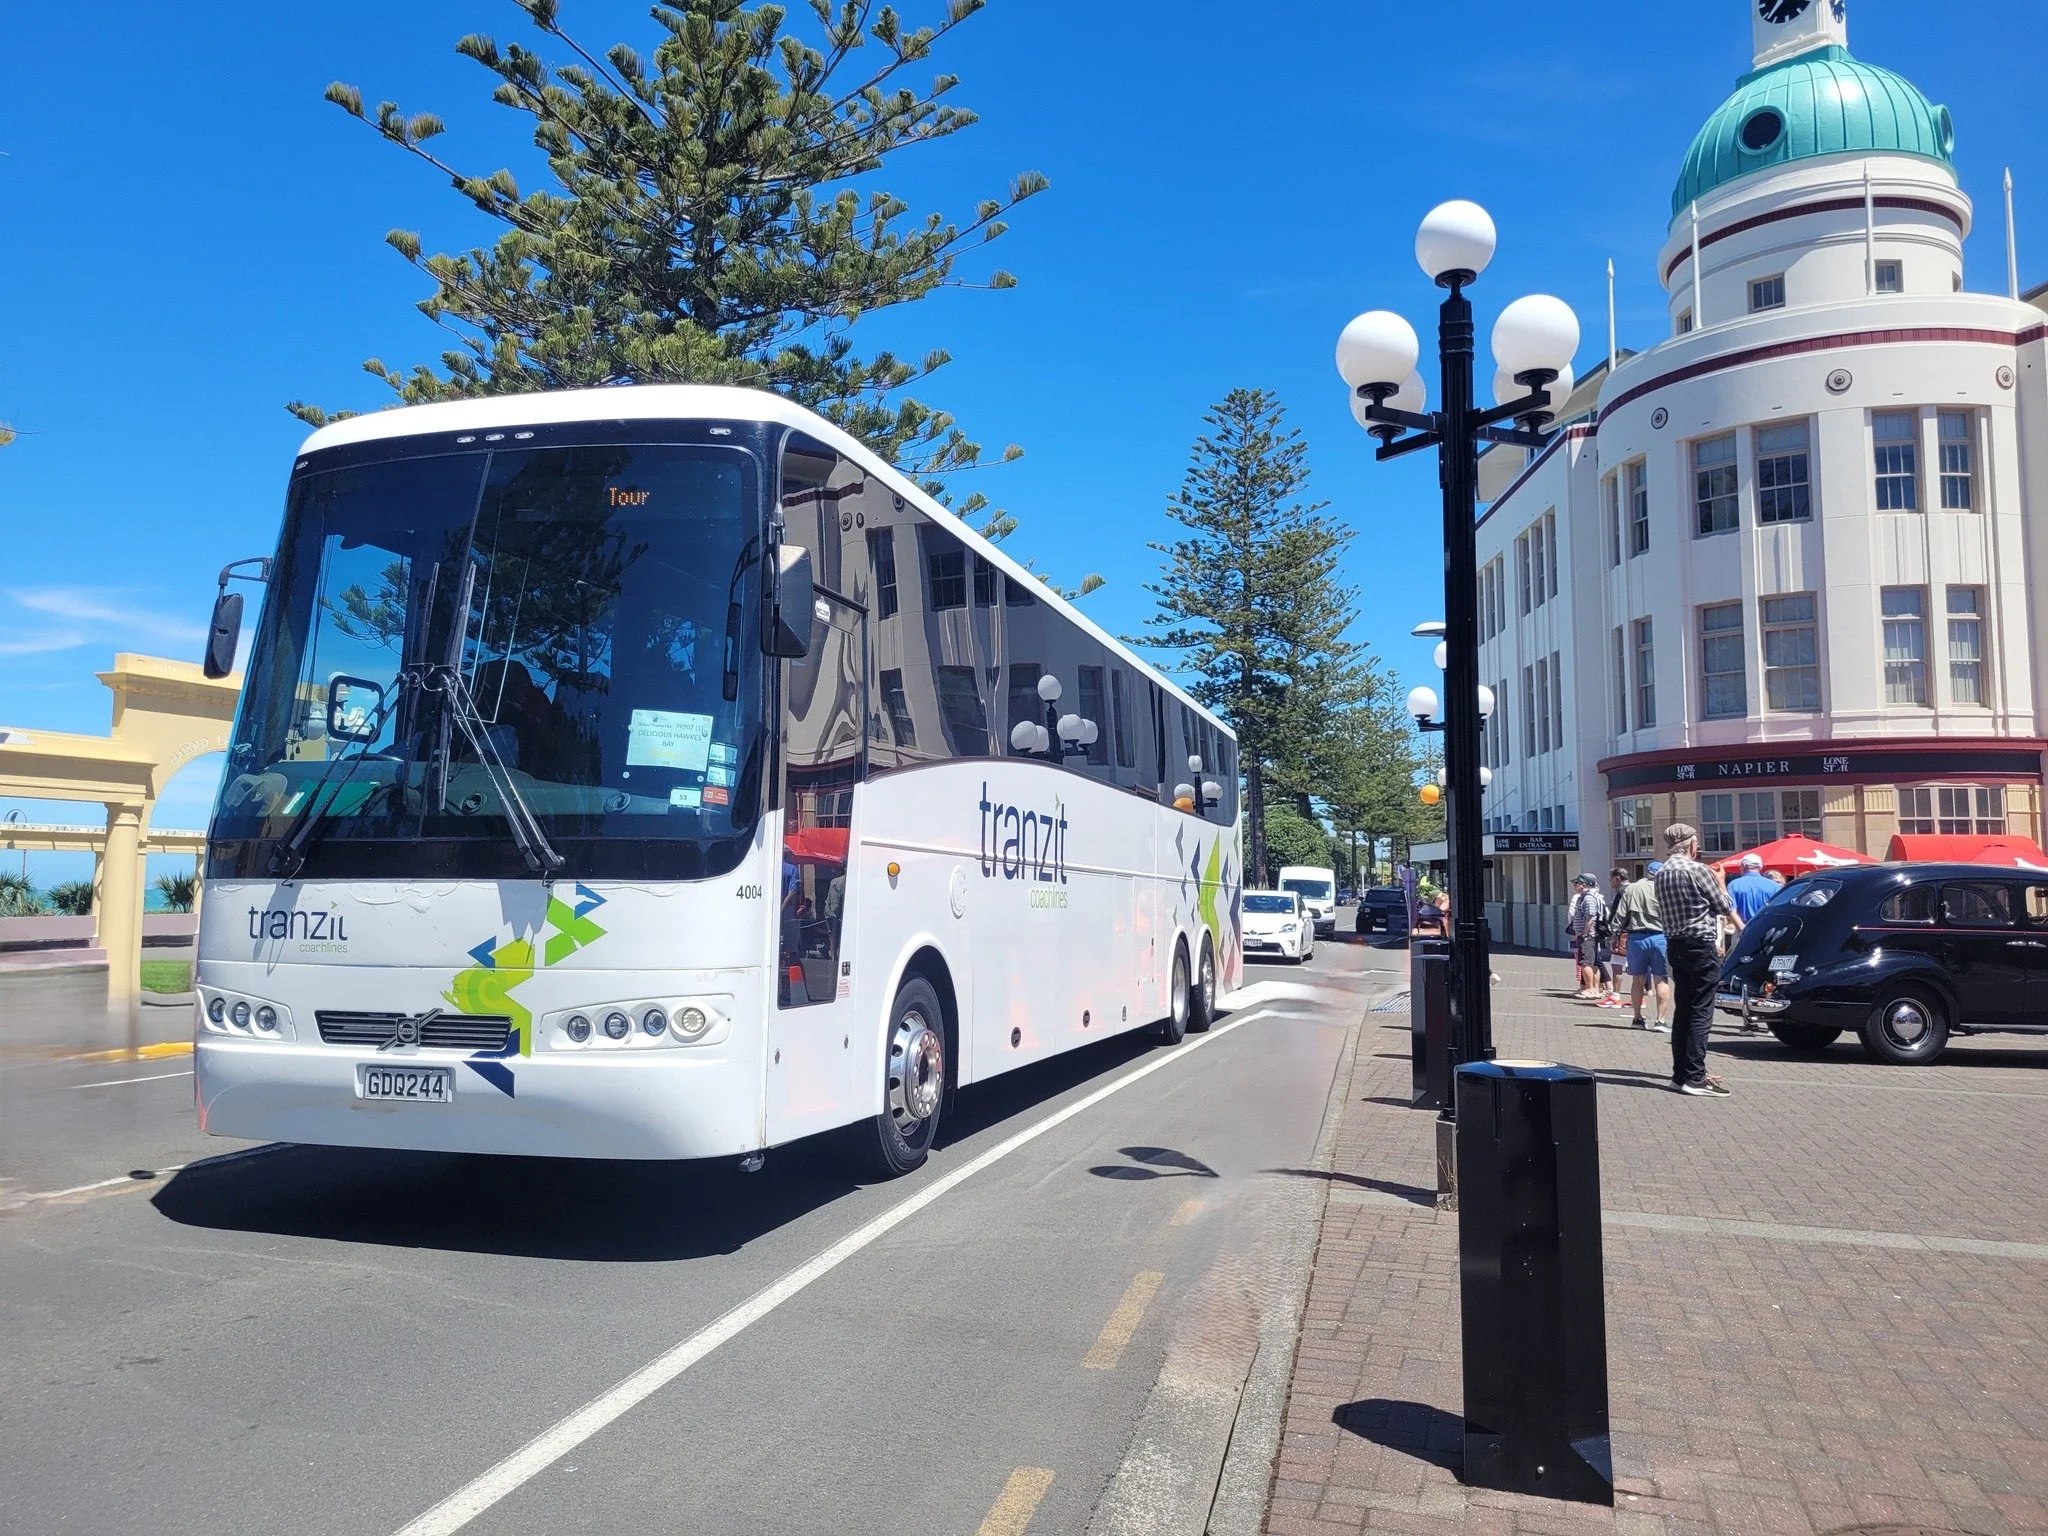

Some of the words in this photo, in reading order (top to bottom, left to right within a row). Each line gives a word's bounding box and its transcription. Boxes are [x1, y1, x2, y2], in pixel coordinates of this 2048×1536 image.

[609, 487, 650, 506] Tour
[638, 730, 673, 738] DELICIOUS
[673, 732, 702, 741] HAWKES
[169, 736, 209, 766] HAROLD
[1676, 764, 1696, 773] LONE
[1718, 760, 1790, 776] NAPIER
[1823, 757, 1849, 765] LONE
[980, 781, 1068, 885] tranzit
[736, 885, 762, 900] 4004
[1030, 884, 1068, 909] coachlines
[299, 942, 349, 953] coachlines
[367, 1071, 444, 1098] GDQ244
